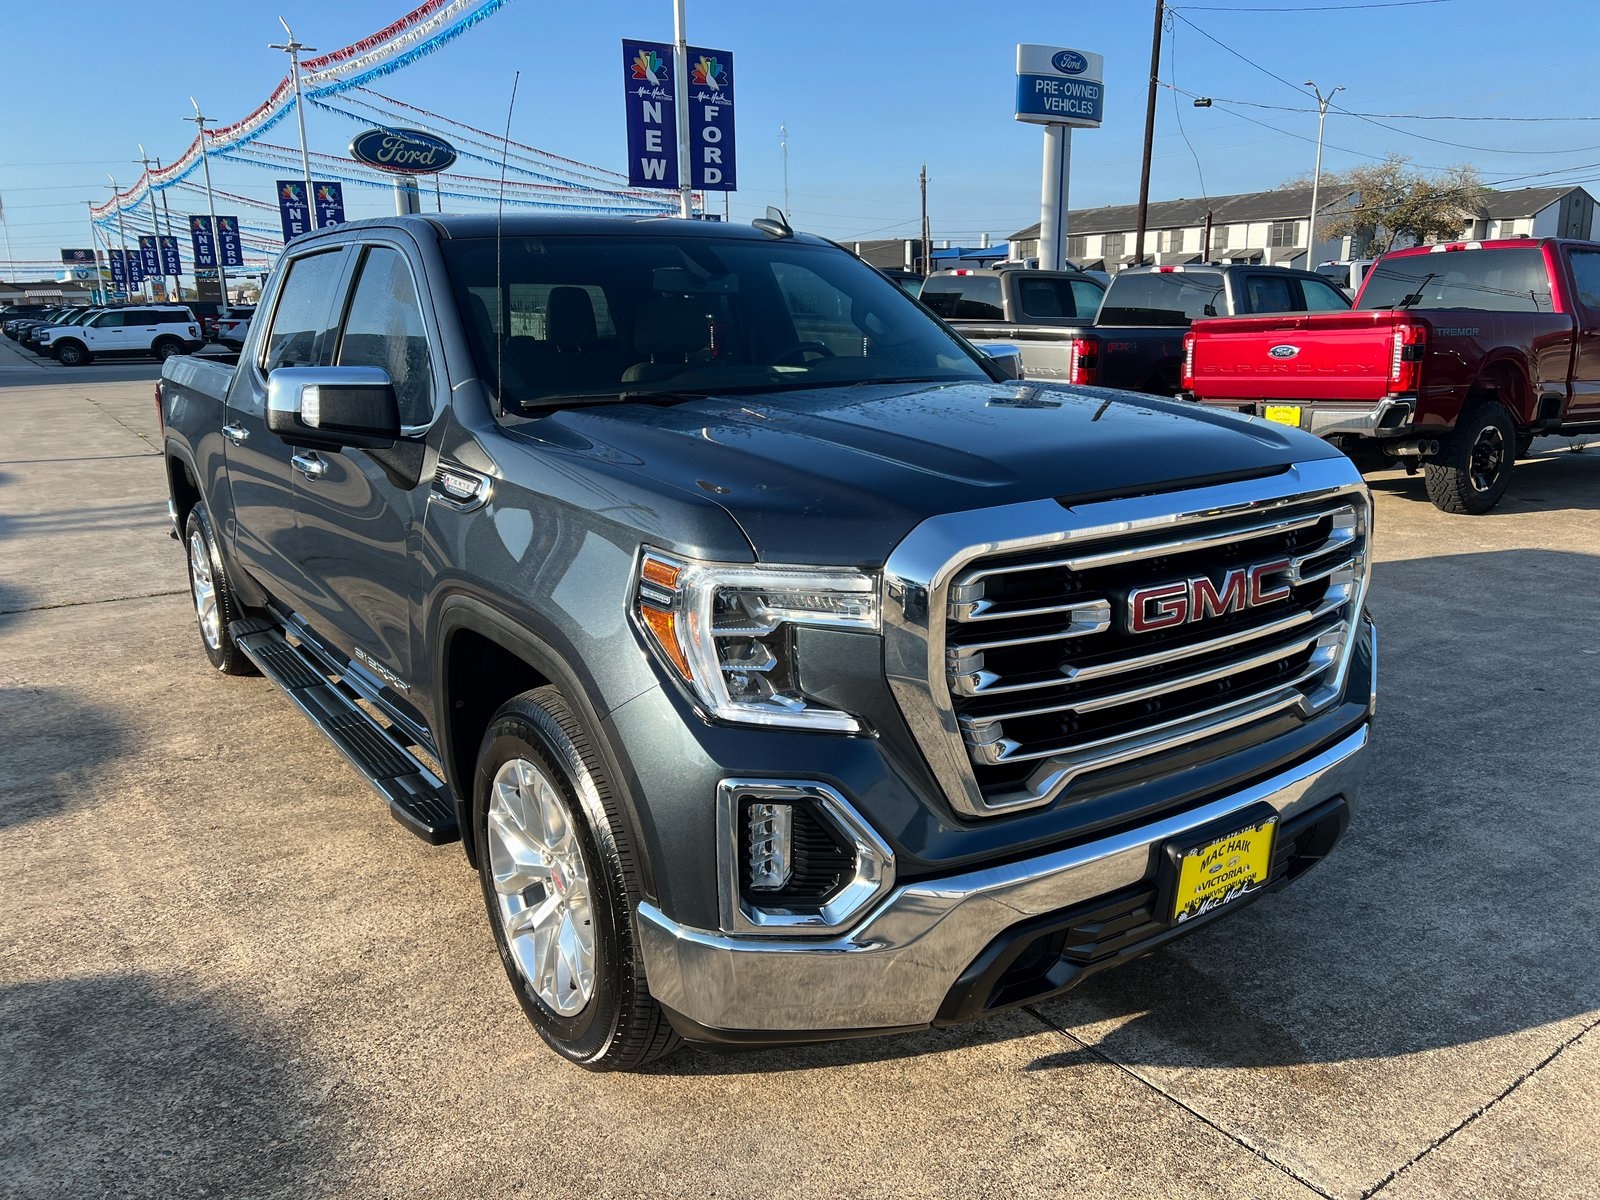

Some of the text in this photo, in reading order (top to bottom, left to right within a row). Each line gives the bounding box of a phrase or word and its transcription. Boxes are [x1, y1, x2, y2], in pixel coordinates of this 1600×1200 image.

[1060, 53, 1081, 70] Ford
[1035, 79, 1099, 100] PRE-OWNED
[1044, 97, 1093, 115] VEHICLES
[376, 136, 437, 165] Ford
[641, 101, 667, 181] NEW
[702, 105, 723, 184] FORD
[289, 208, 304, 239] NE
[325, 209, 338, 228] FO
[198, 235, 212, 264] NEW
[225, 235, 237, 264] FORD
[113, 262, 123, 281] NEW
[131, 262, 139, 281] FORD
[145, 251, 157, 274] NEW
[167, 250, 177, 274] FORD
[1436, 327, 1480, 337] TREMOR
[1107, 342, 1137, 353] FX4
[1025, 366, 1063, 376] UTY
[1203, 364, 1375, 373] SUPER DUTY
[1128, 556, 1291, 634] GMC
[1200, 844, 1226, 873] MAC
[1226, 839, 1251, 854] HAIK
[1201, 866, 1243, 891] VICTORIA
[1196, 882, 1252, 915] Mac Haik
